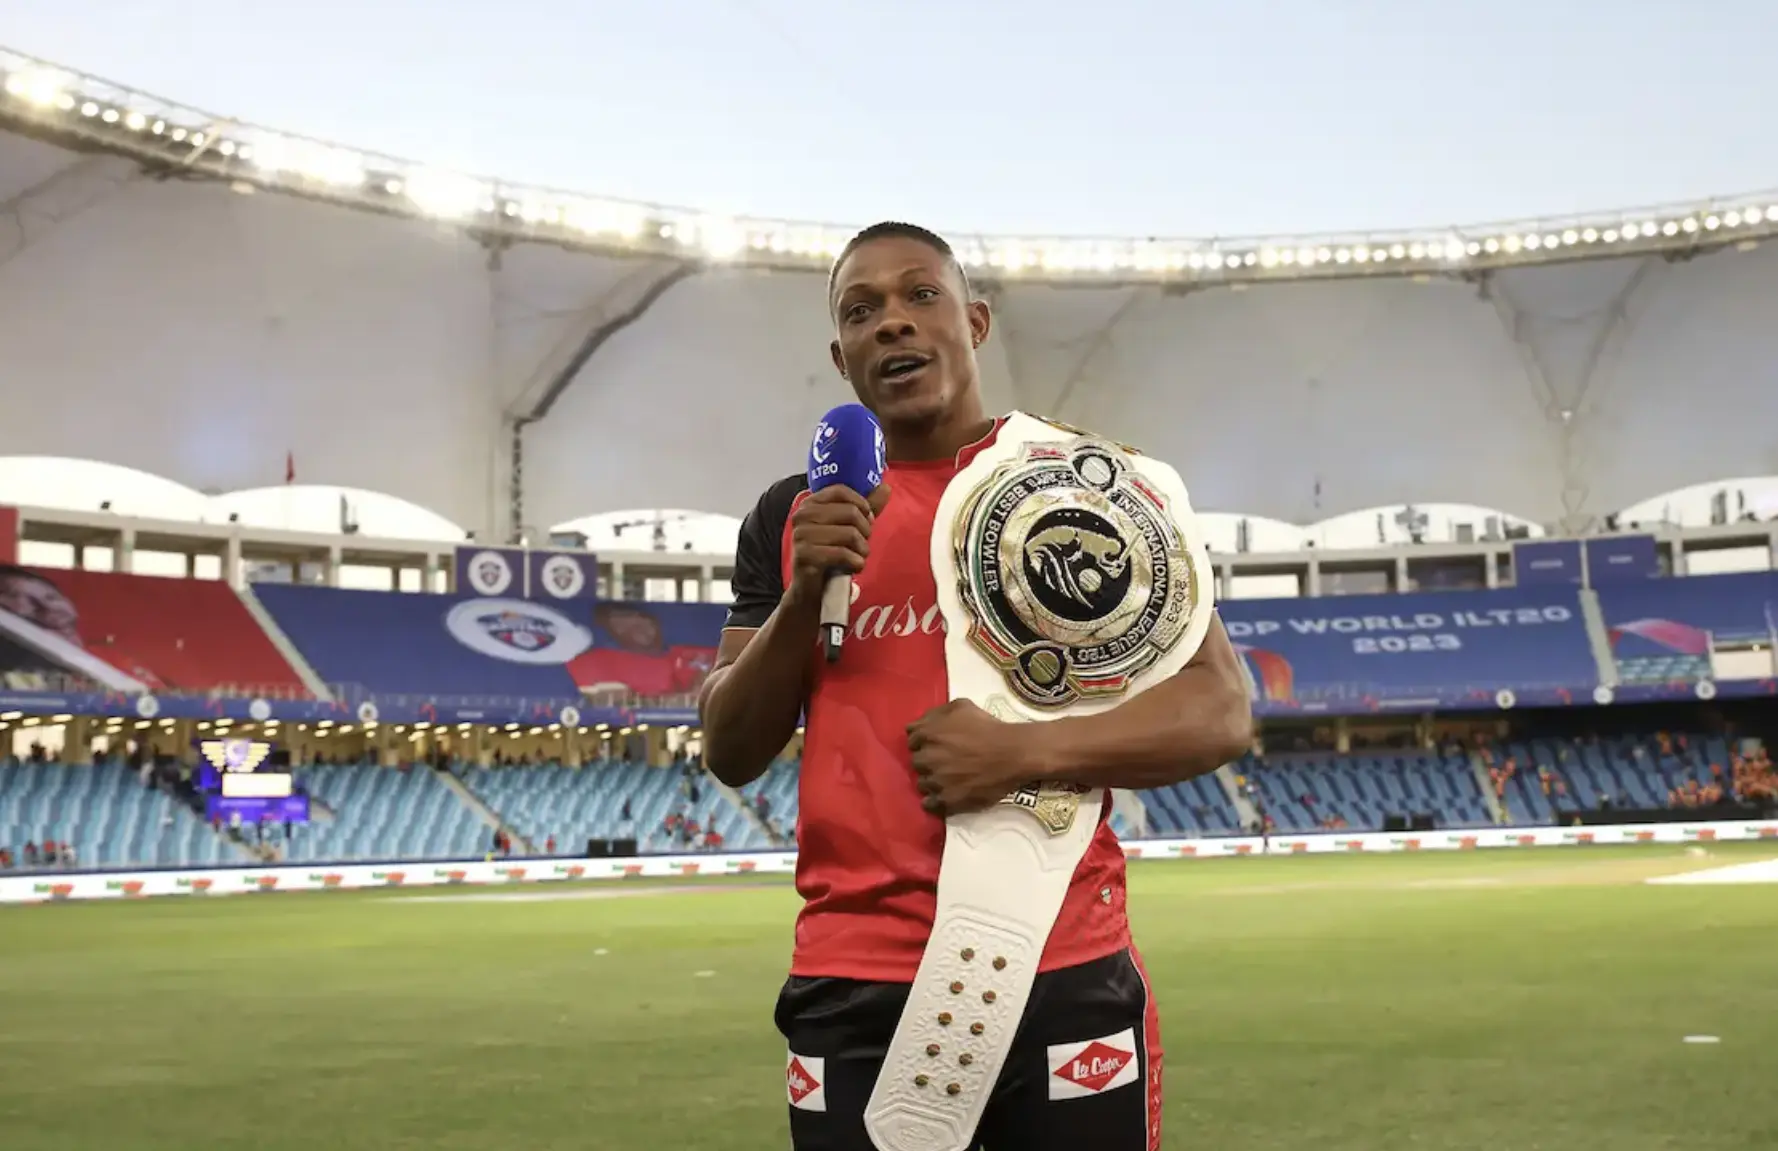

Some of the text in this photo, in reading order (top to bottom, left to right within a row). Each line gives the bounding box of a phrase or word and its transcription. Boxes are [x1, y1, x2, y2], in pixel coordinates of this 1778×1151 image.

[982, 484, 1028, 593] BEST BOWLER
[1116, 494, 1166, 607] INTERNATIONAL
[1165, 579, 1187, 624] 2023
[1227, 605, 1573, 638] DP WORLD ILT20
[1108, 607, 1158, 655] LEAGUE
[1352, 633, 1462, 654] 2023
